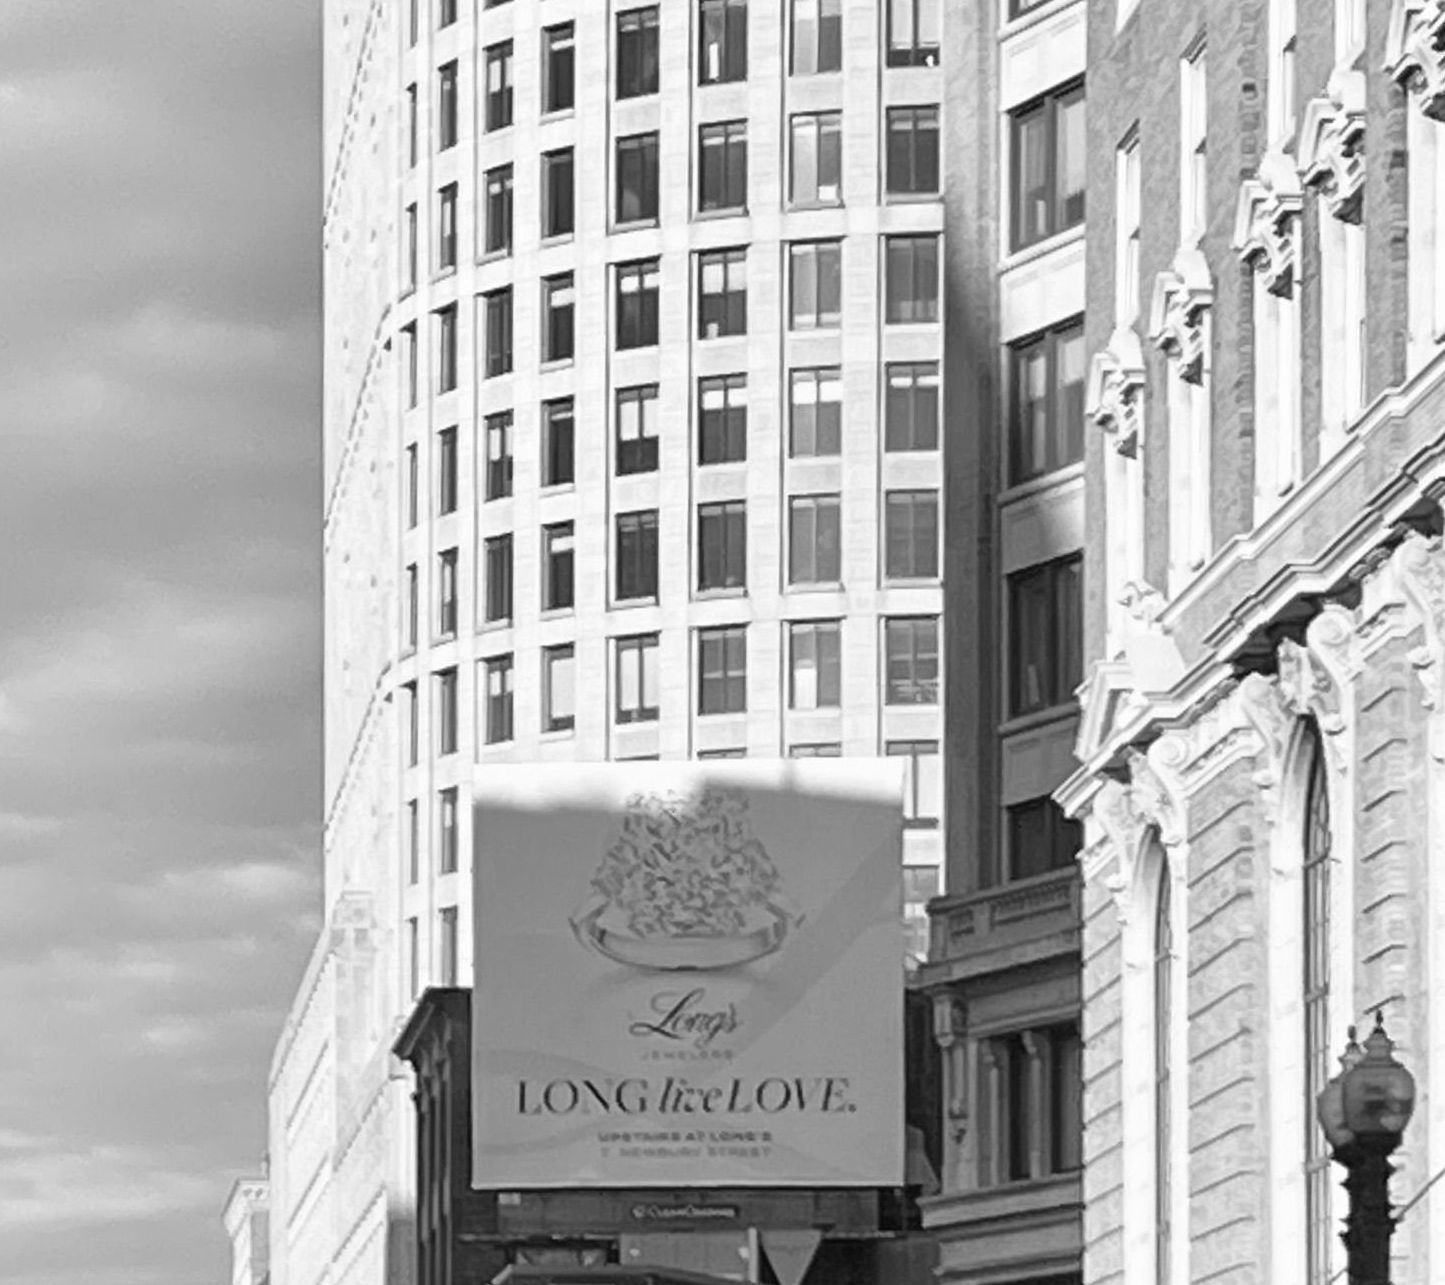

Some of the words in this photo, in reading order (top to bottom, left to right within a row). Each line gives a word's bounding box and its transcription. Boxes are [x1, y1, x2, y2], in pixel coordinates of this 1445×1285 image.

[518, 1079, 648, 1114] LONG
[658, 1077, 722, 1113] live
[727, 1077, 858, 1113] LOVE.
